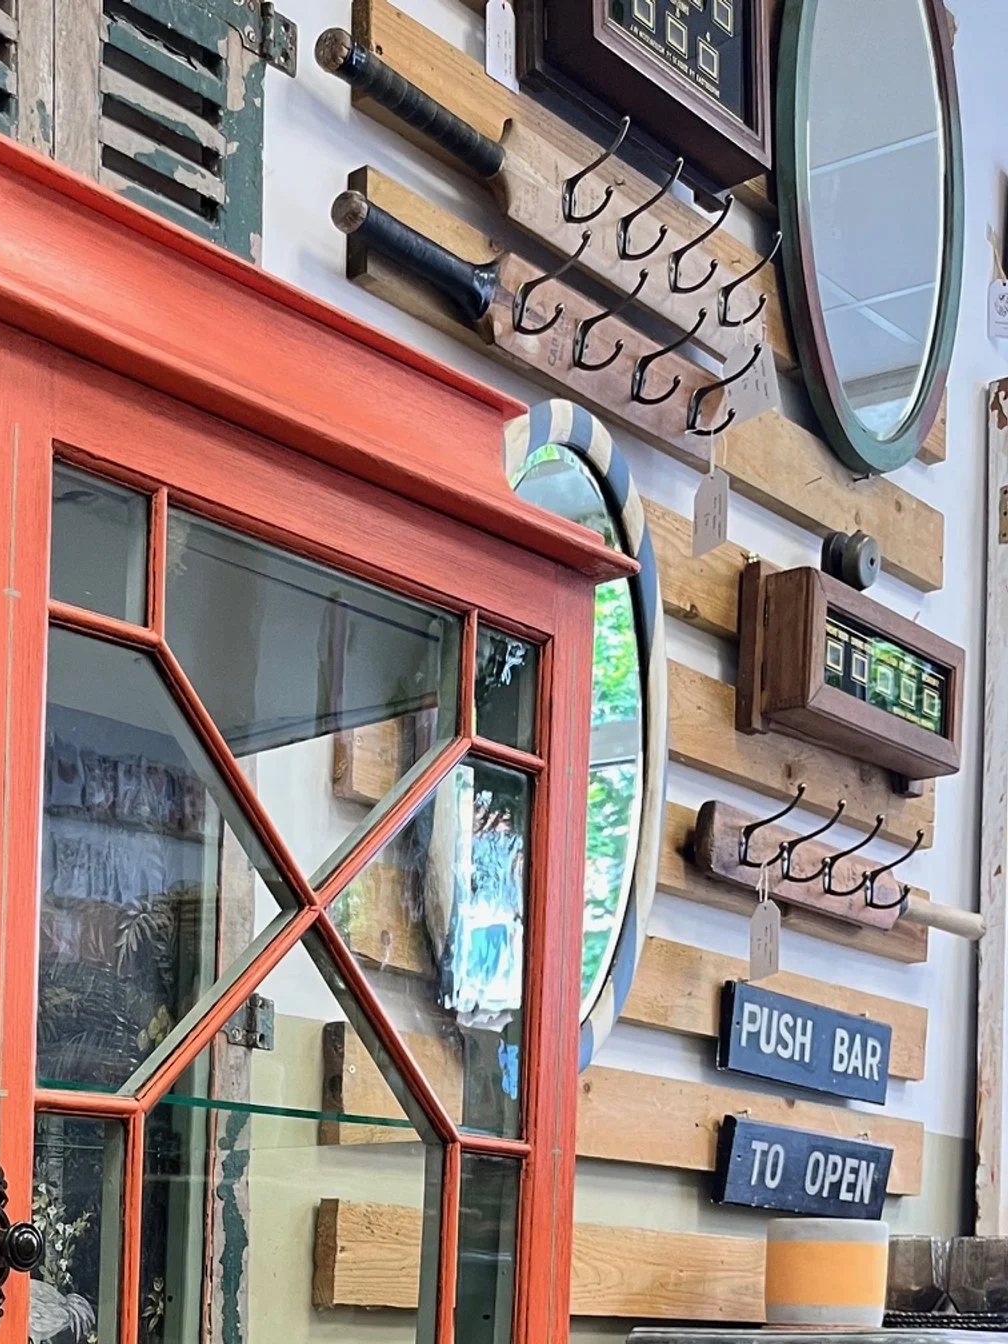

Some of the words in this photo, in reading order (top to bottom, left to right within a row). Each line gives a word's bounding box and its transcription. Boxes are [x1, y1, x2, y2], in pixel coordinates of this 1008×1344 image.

[740, 1002, 813, 1063] PUSH
[832, 1028, 881, 1081] BAR
[750, 1140, 785, 1189] TO
[804, 1151, 875, 1204] OPEN
